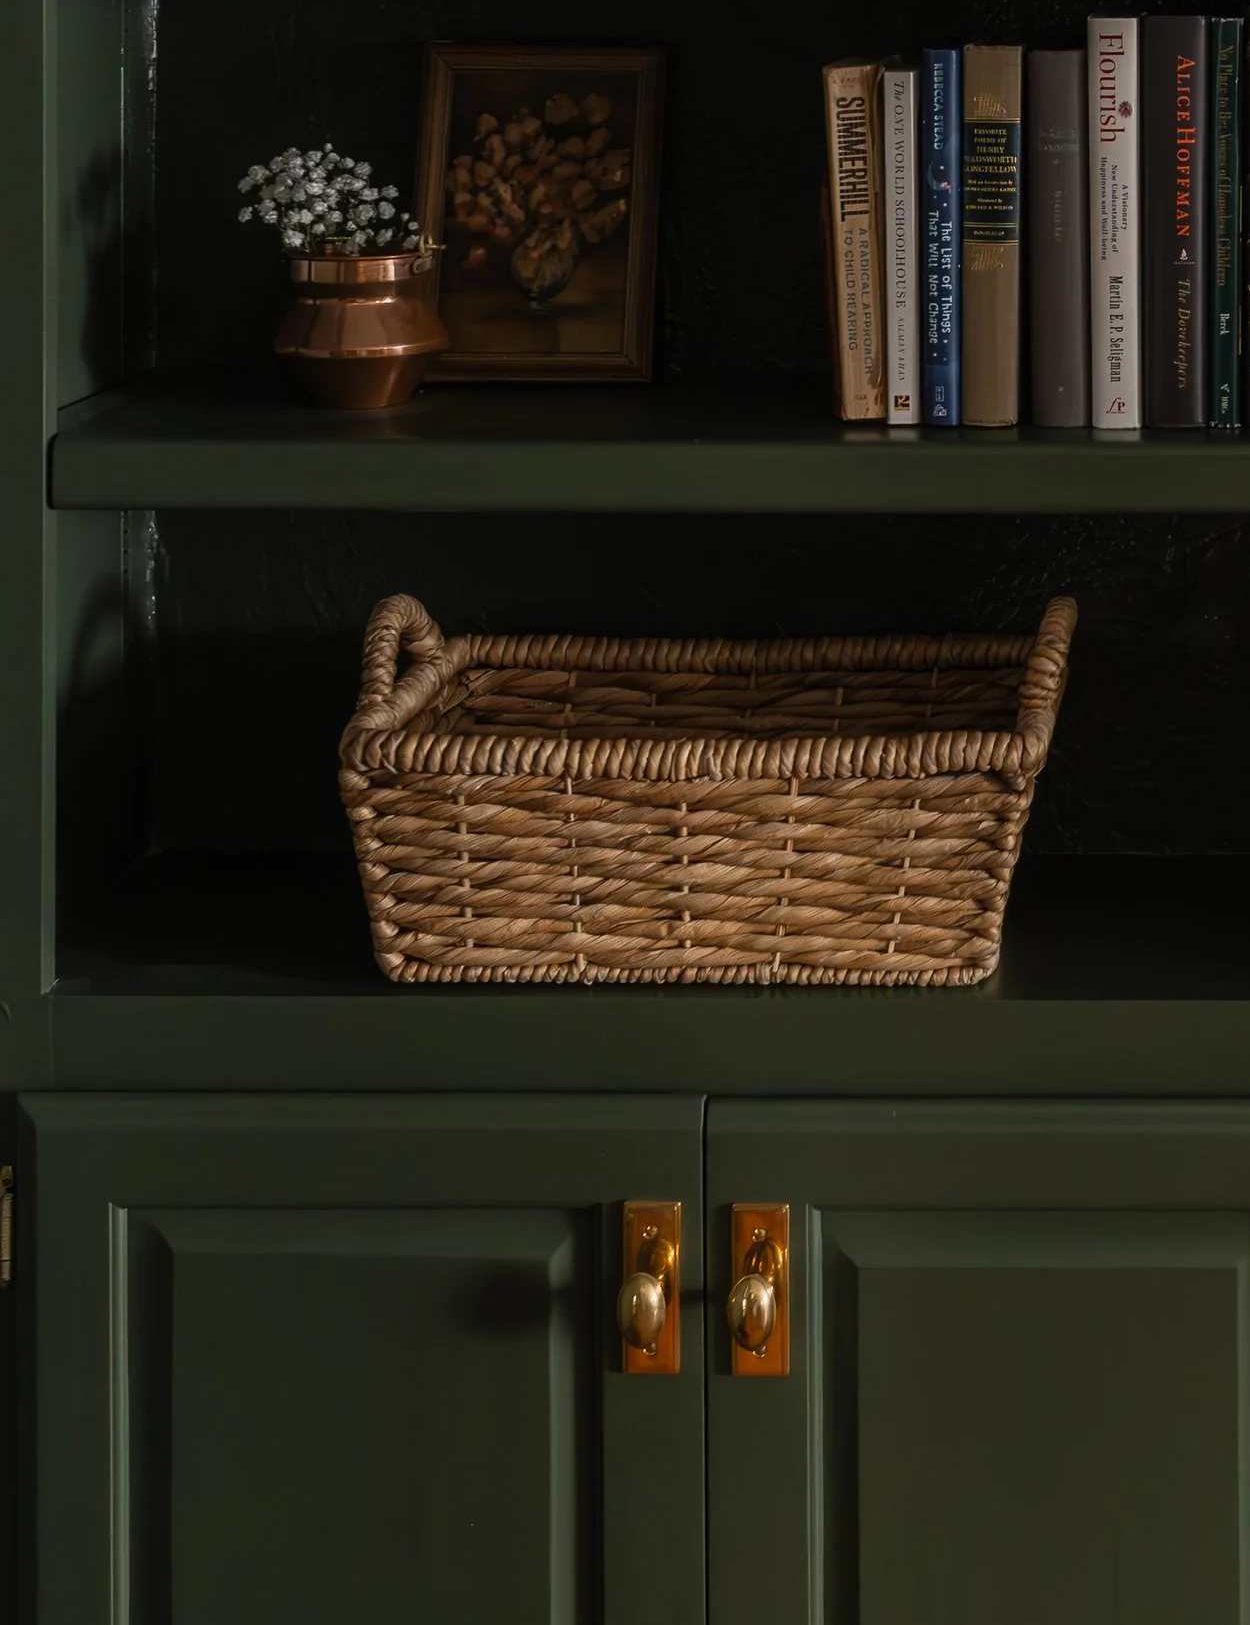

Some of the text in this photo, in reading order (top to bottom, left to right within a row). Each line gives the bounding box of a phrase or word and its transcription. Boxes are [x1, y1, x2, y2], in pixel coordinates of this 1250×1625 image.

[1098, 33, 1124, 143] Flourish
[1176, 55, 1196, 236] ALICE HOFFMAN
[835, 97, 869, 222] SUMMERHILL
[893, 81, 906, 308] The ONE WORLD SCHOOLHOUSE
[1108, 276, 1124, 382] Martin E. P. Seligman
[1219, 313, 1230, 335] Berek
